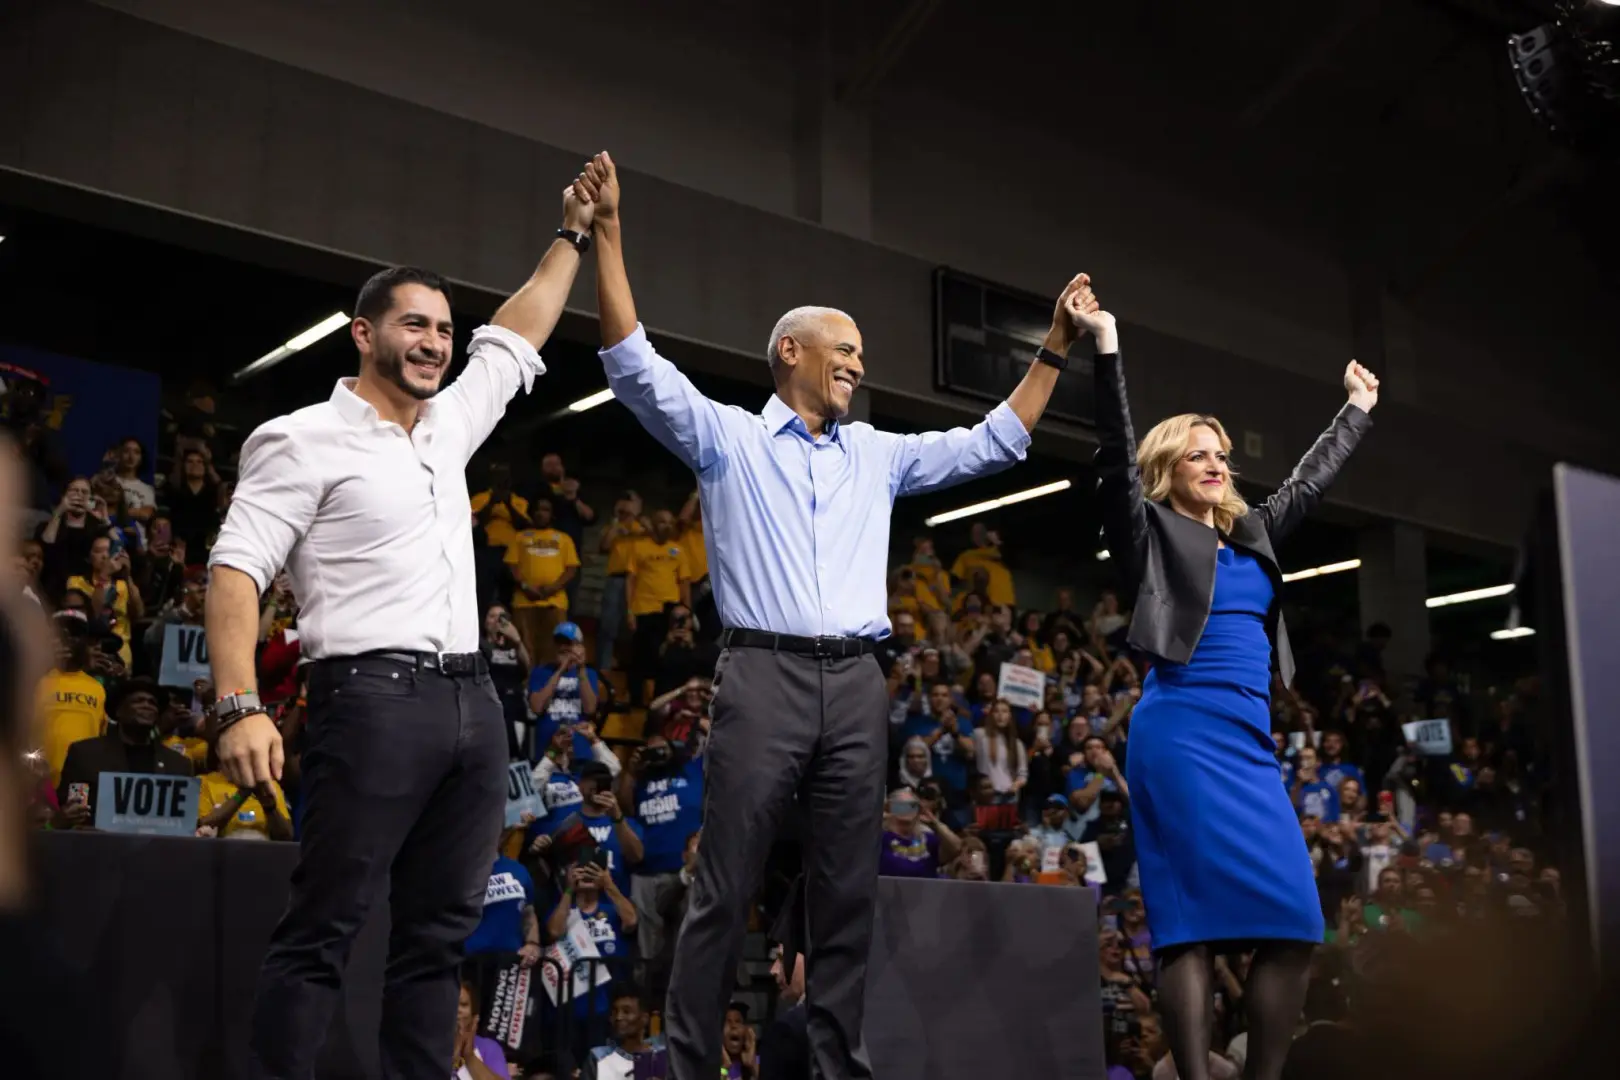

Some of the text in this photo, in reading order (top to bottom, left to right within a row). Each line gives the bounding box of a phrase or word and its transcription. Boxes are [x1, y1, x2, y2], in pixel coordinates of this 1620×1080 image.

[56, 691, 97, 709] UFCW
[114, 776, 188, 817] VOTE
[487, 968, 508, 1033] MOVING
[496, 963, 519, 1042] MICHIGAN
